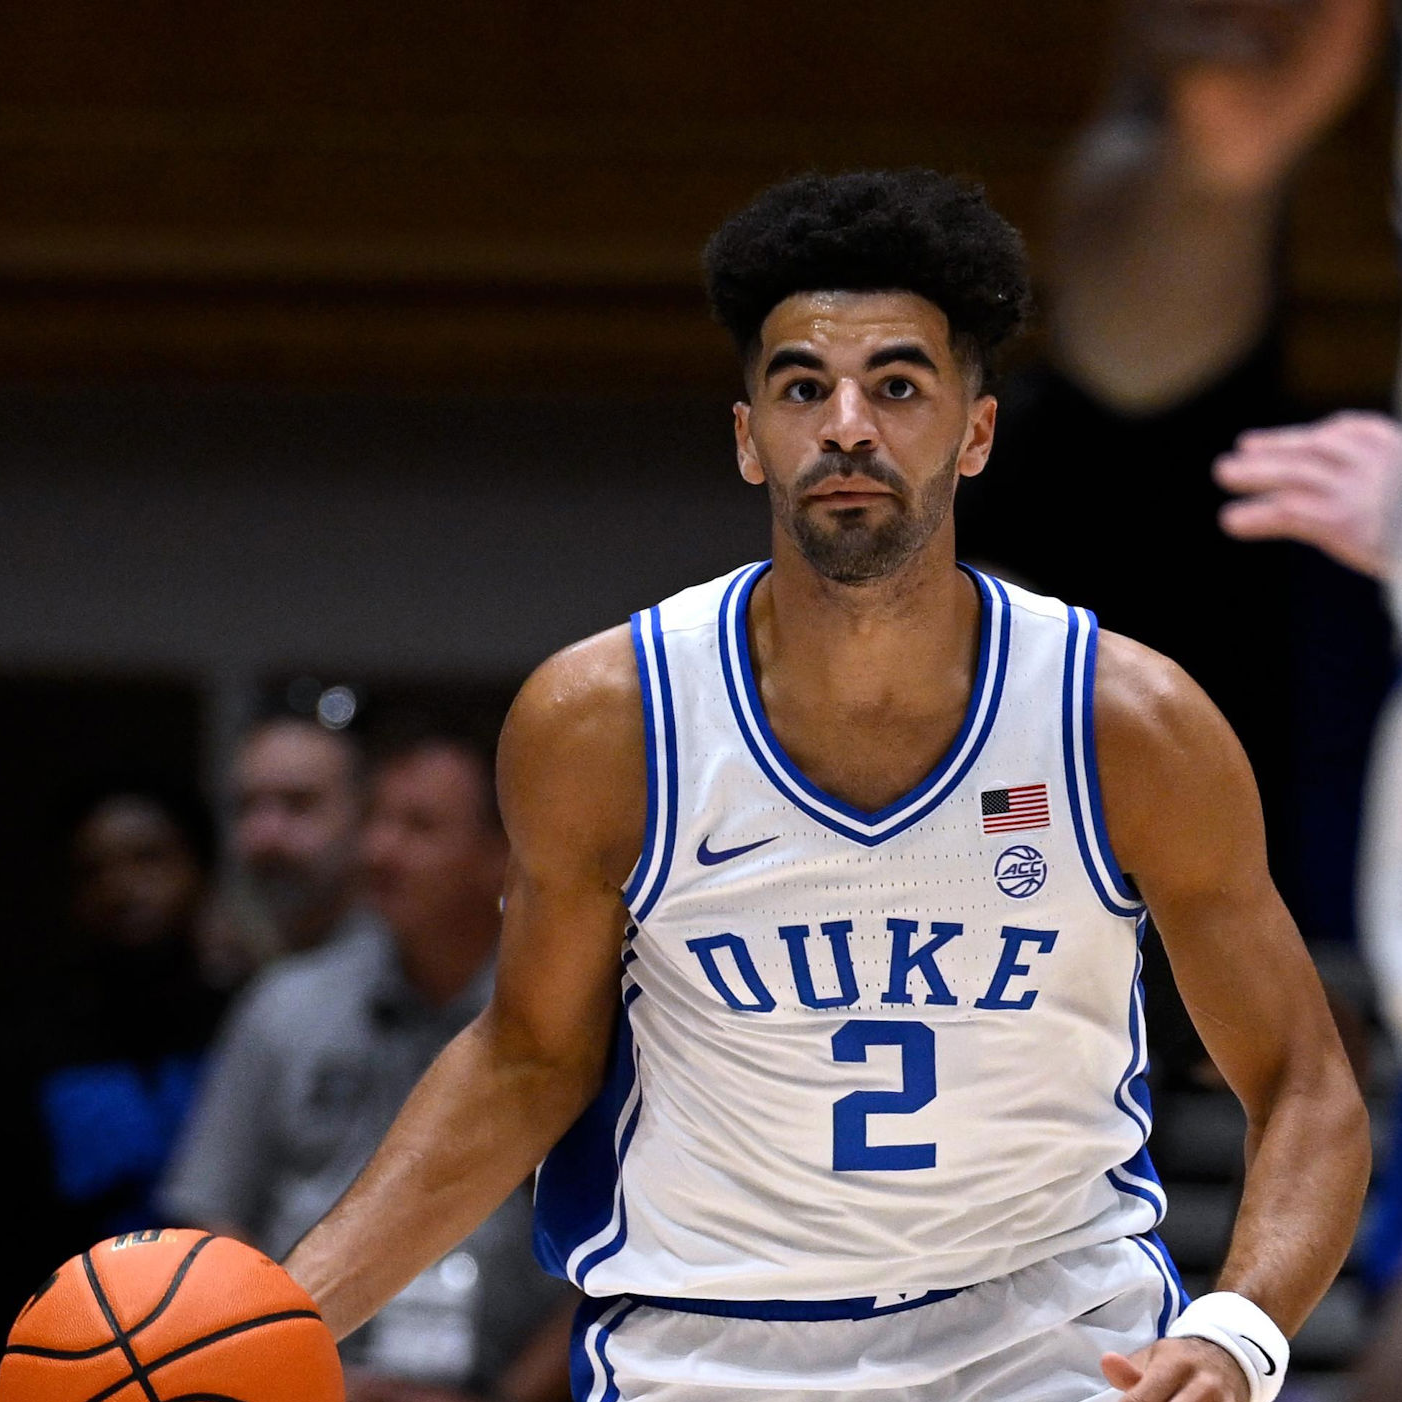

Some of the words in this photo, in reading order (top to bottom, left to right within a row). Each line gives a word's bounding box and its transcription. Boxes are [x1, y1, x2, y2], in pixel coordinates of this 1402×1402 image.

[1001, 860, 1044, 876] ACC
[686, 917, 1059, 1013] DUKE
[831, 1019, 937, 1171] 2
